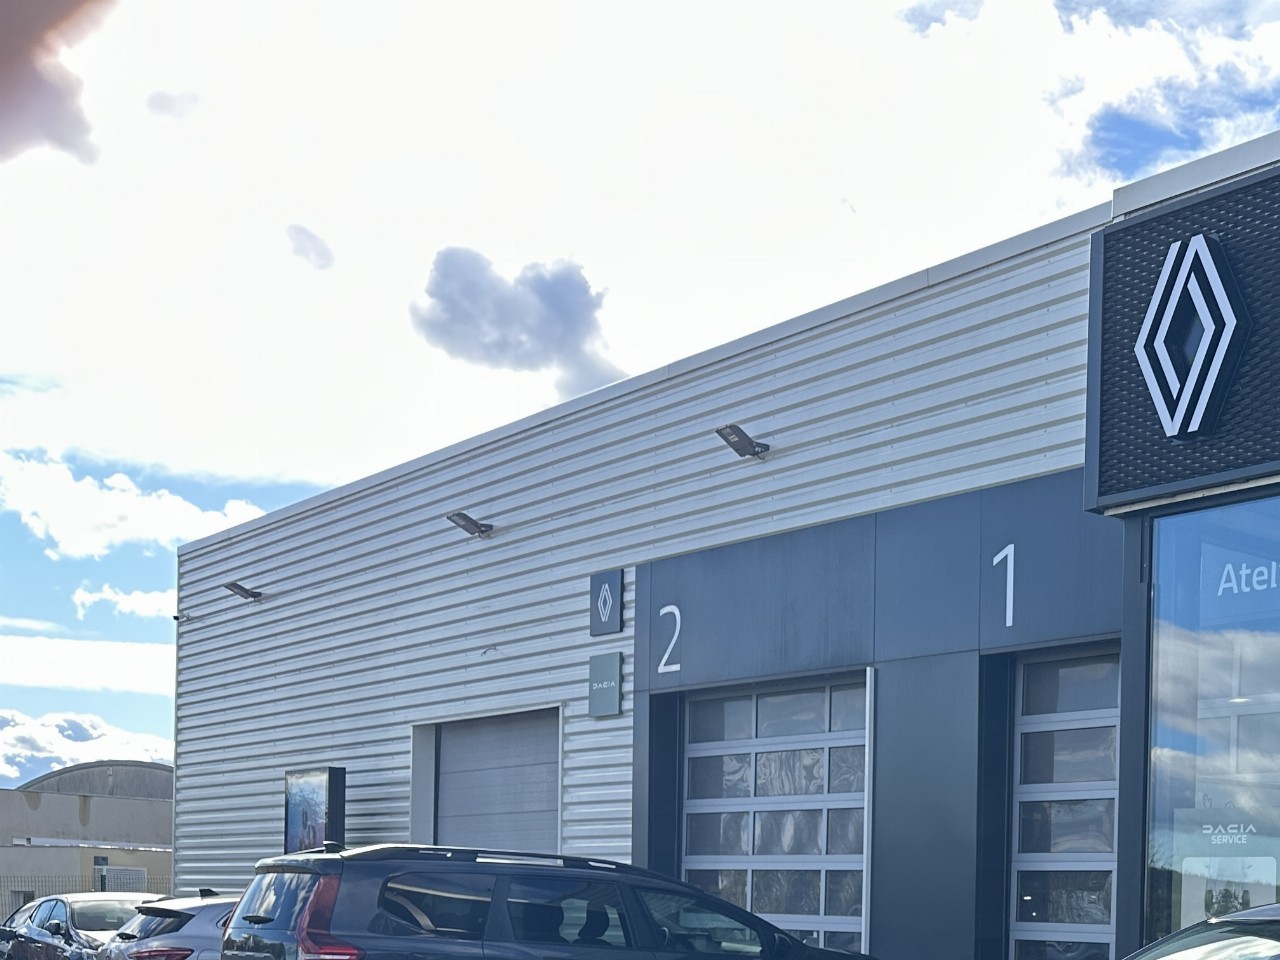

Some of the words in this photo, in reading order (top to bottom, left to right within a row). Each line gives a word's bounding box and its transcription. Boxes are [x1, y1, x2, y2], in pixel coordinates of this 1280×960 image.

[993, 544, 1014, 626] 1
[657, 605, 681, 673] 2
[593, 681, 615, 689] DACIA
[1202, 824, 1256, 833] DACIA
[1211, 835, 1247, 844] SERVICE
